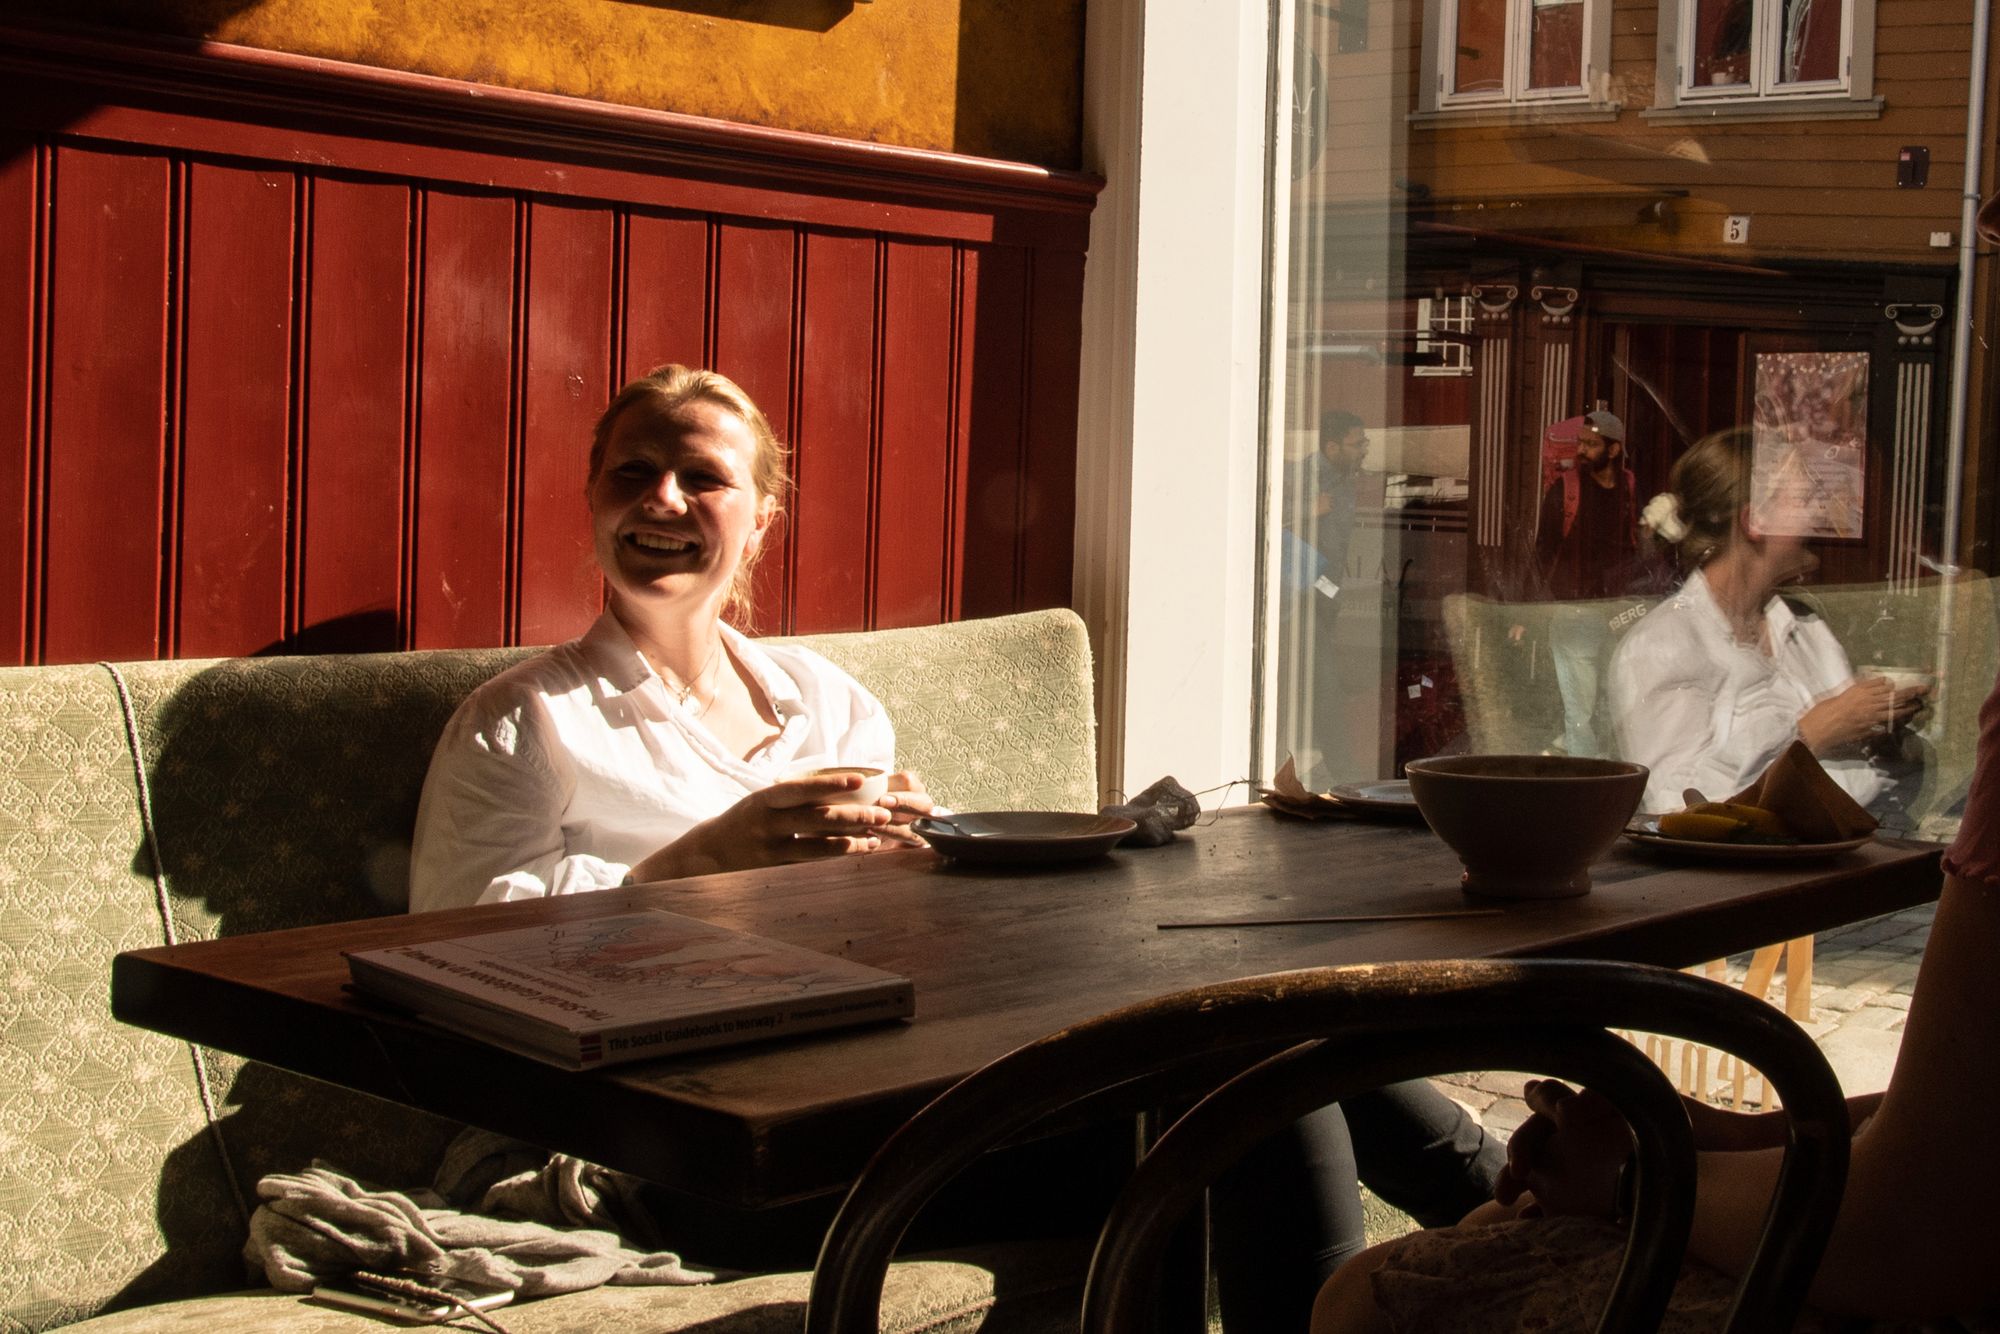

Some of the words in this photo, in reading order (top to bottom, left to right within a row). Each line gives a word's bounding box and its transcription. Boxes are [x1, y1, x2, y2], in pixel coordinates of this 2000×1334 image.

[1730, 219, 1741, 241] 5
[1608, 603, 1647, 631] BERG
[608, 1037, 629, 1051] The
[631, 1030, 662, 1049] Social
[664, 1022, 721, 1044] Guidebook
[723, 1020, 735, 1033] to
[736, 1014, 775, 1031] Norway
